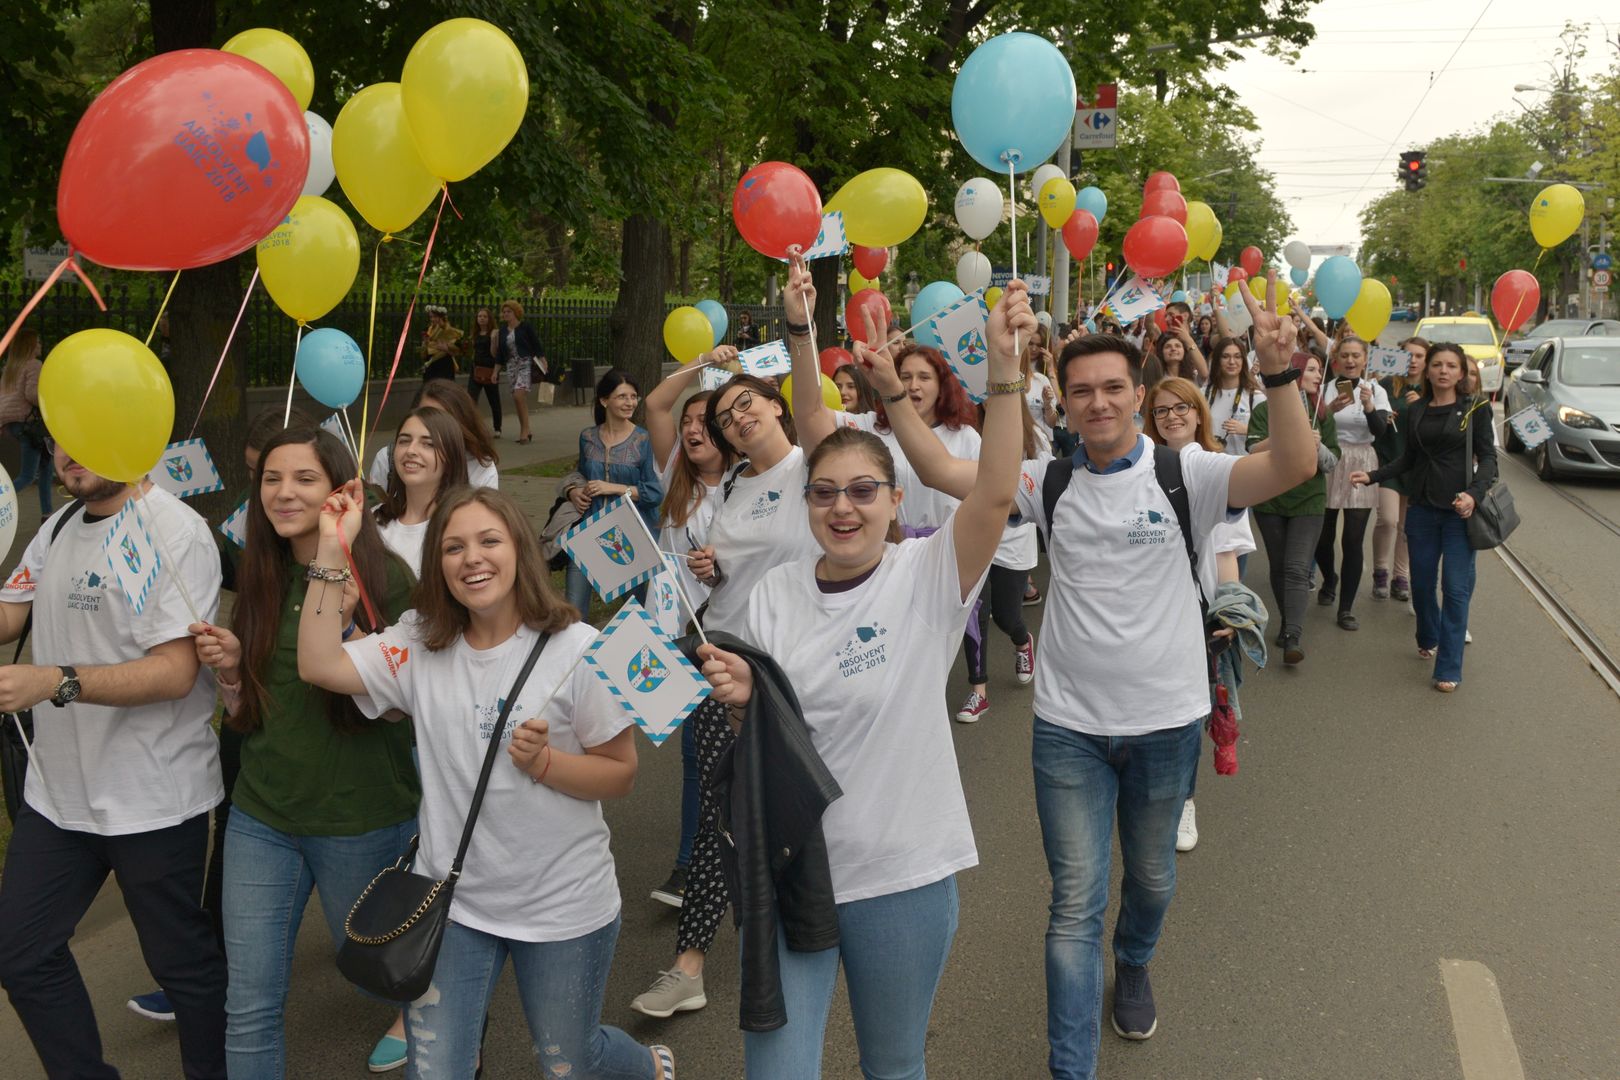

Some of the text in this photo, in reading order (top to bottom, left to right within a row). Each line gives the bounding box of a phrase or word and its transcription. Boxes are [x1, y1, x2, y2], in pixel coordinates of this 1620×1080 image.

[181, 120, 252, 194] ABSOLVENT
[175, 131, 236, 202] UAIC 2018
[1597, 273, 1608, 281] 30
[1127, 529, 1167, 538] ABSOLVENT
[67, 602, 99, 612] UAIC 2018
[68, 592, 102, 604] ABSOLVENT
[838, 643, 886, 670] ABSOLVENT
[842, 654, 887, 678] UAIC 2018
